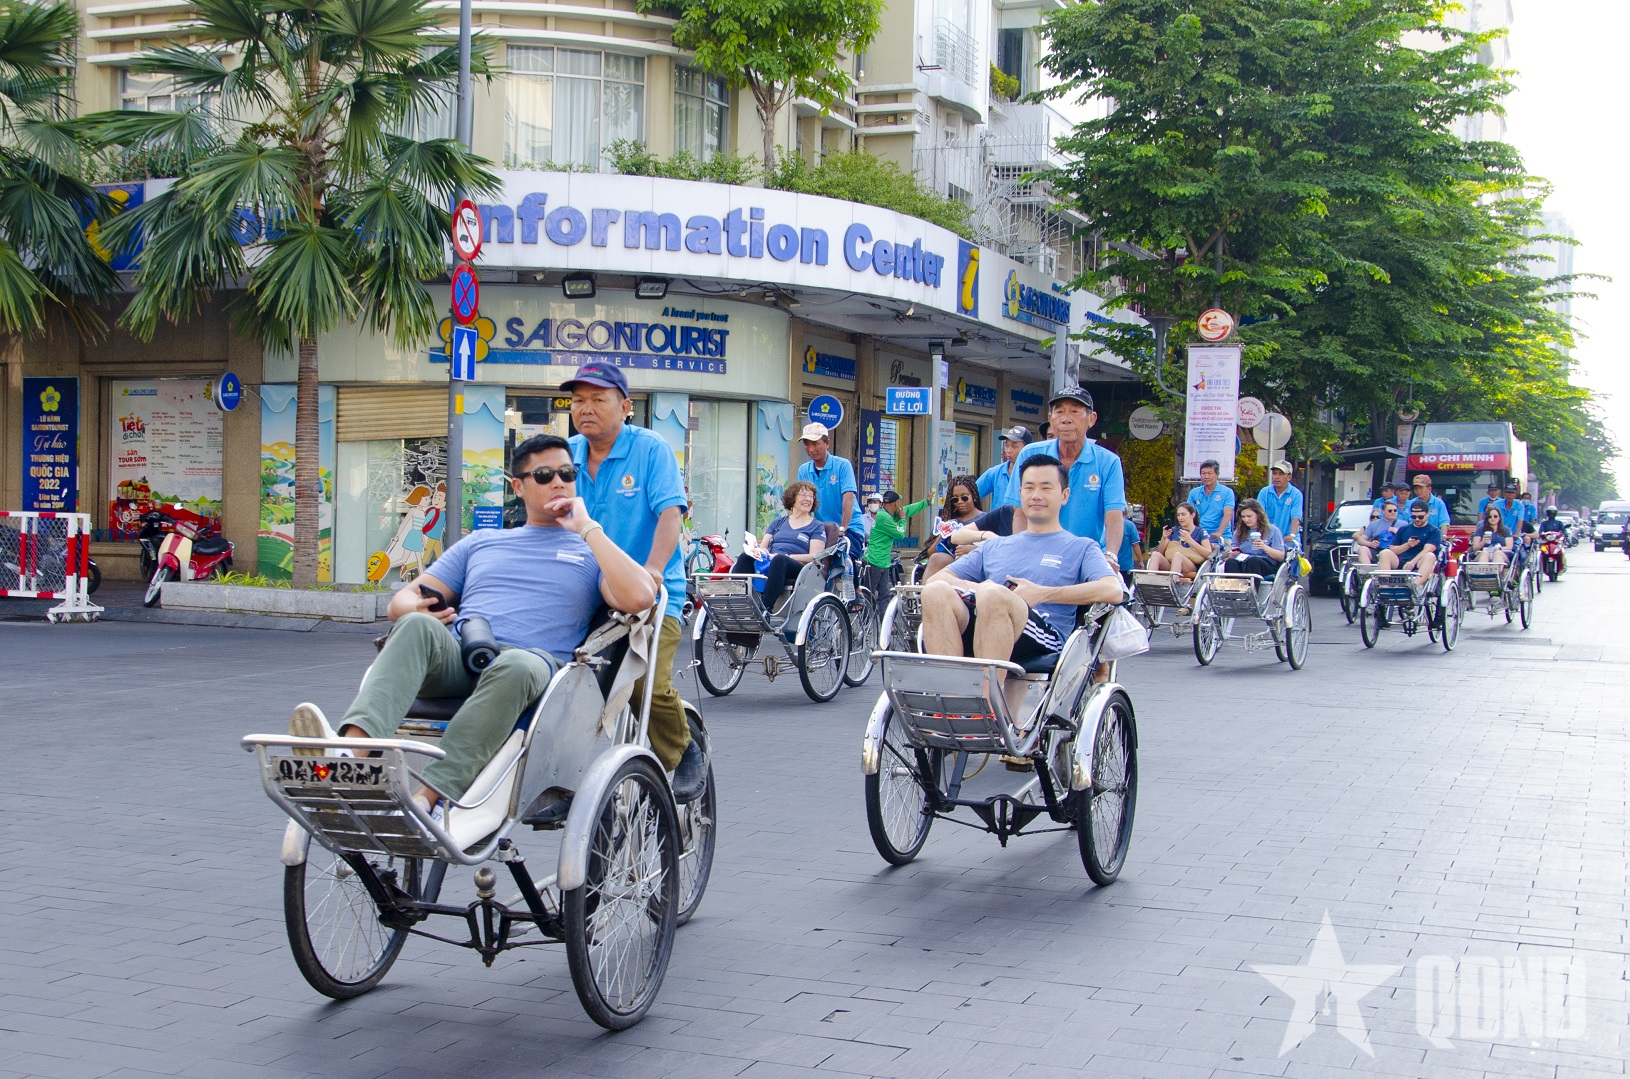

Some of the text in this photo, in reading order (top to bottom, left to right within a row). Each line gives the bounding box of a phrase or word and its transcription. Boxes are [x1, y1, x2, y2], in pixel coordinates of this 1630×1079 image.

[450, 190, 829, 266] nformation
[843, 222, 945, 289] Center
[504, 317, 730, 357] SAIGONTOURIST
[556, 355, 725, 372] TRAVEL SERVICE
[895, 390, 921, 399] ĐƯỜNG
[555, 398, 572, 408] OP
[893, 400, 923, 413] LÊ LỢI
[1419, 454, 1495, 464] HO CHI MINH
[30, 463, 69, 478] QUỐC GIA
[38, 479, 60, 490] 2022
